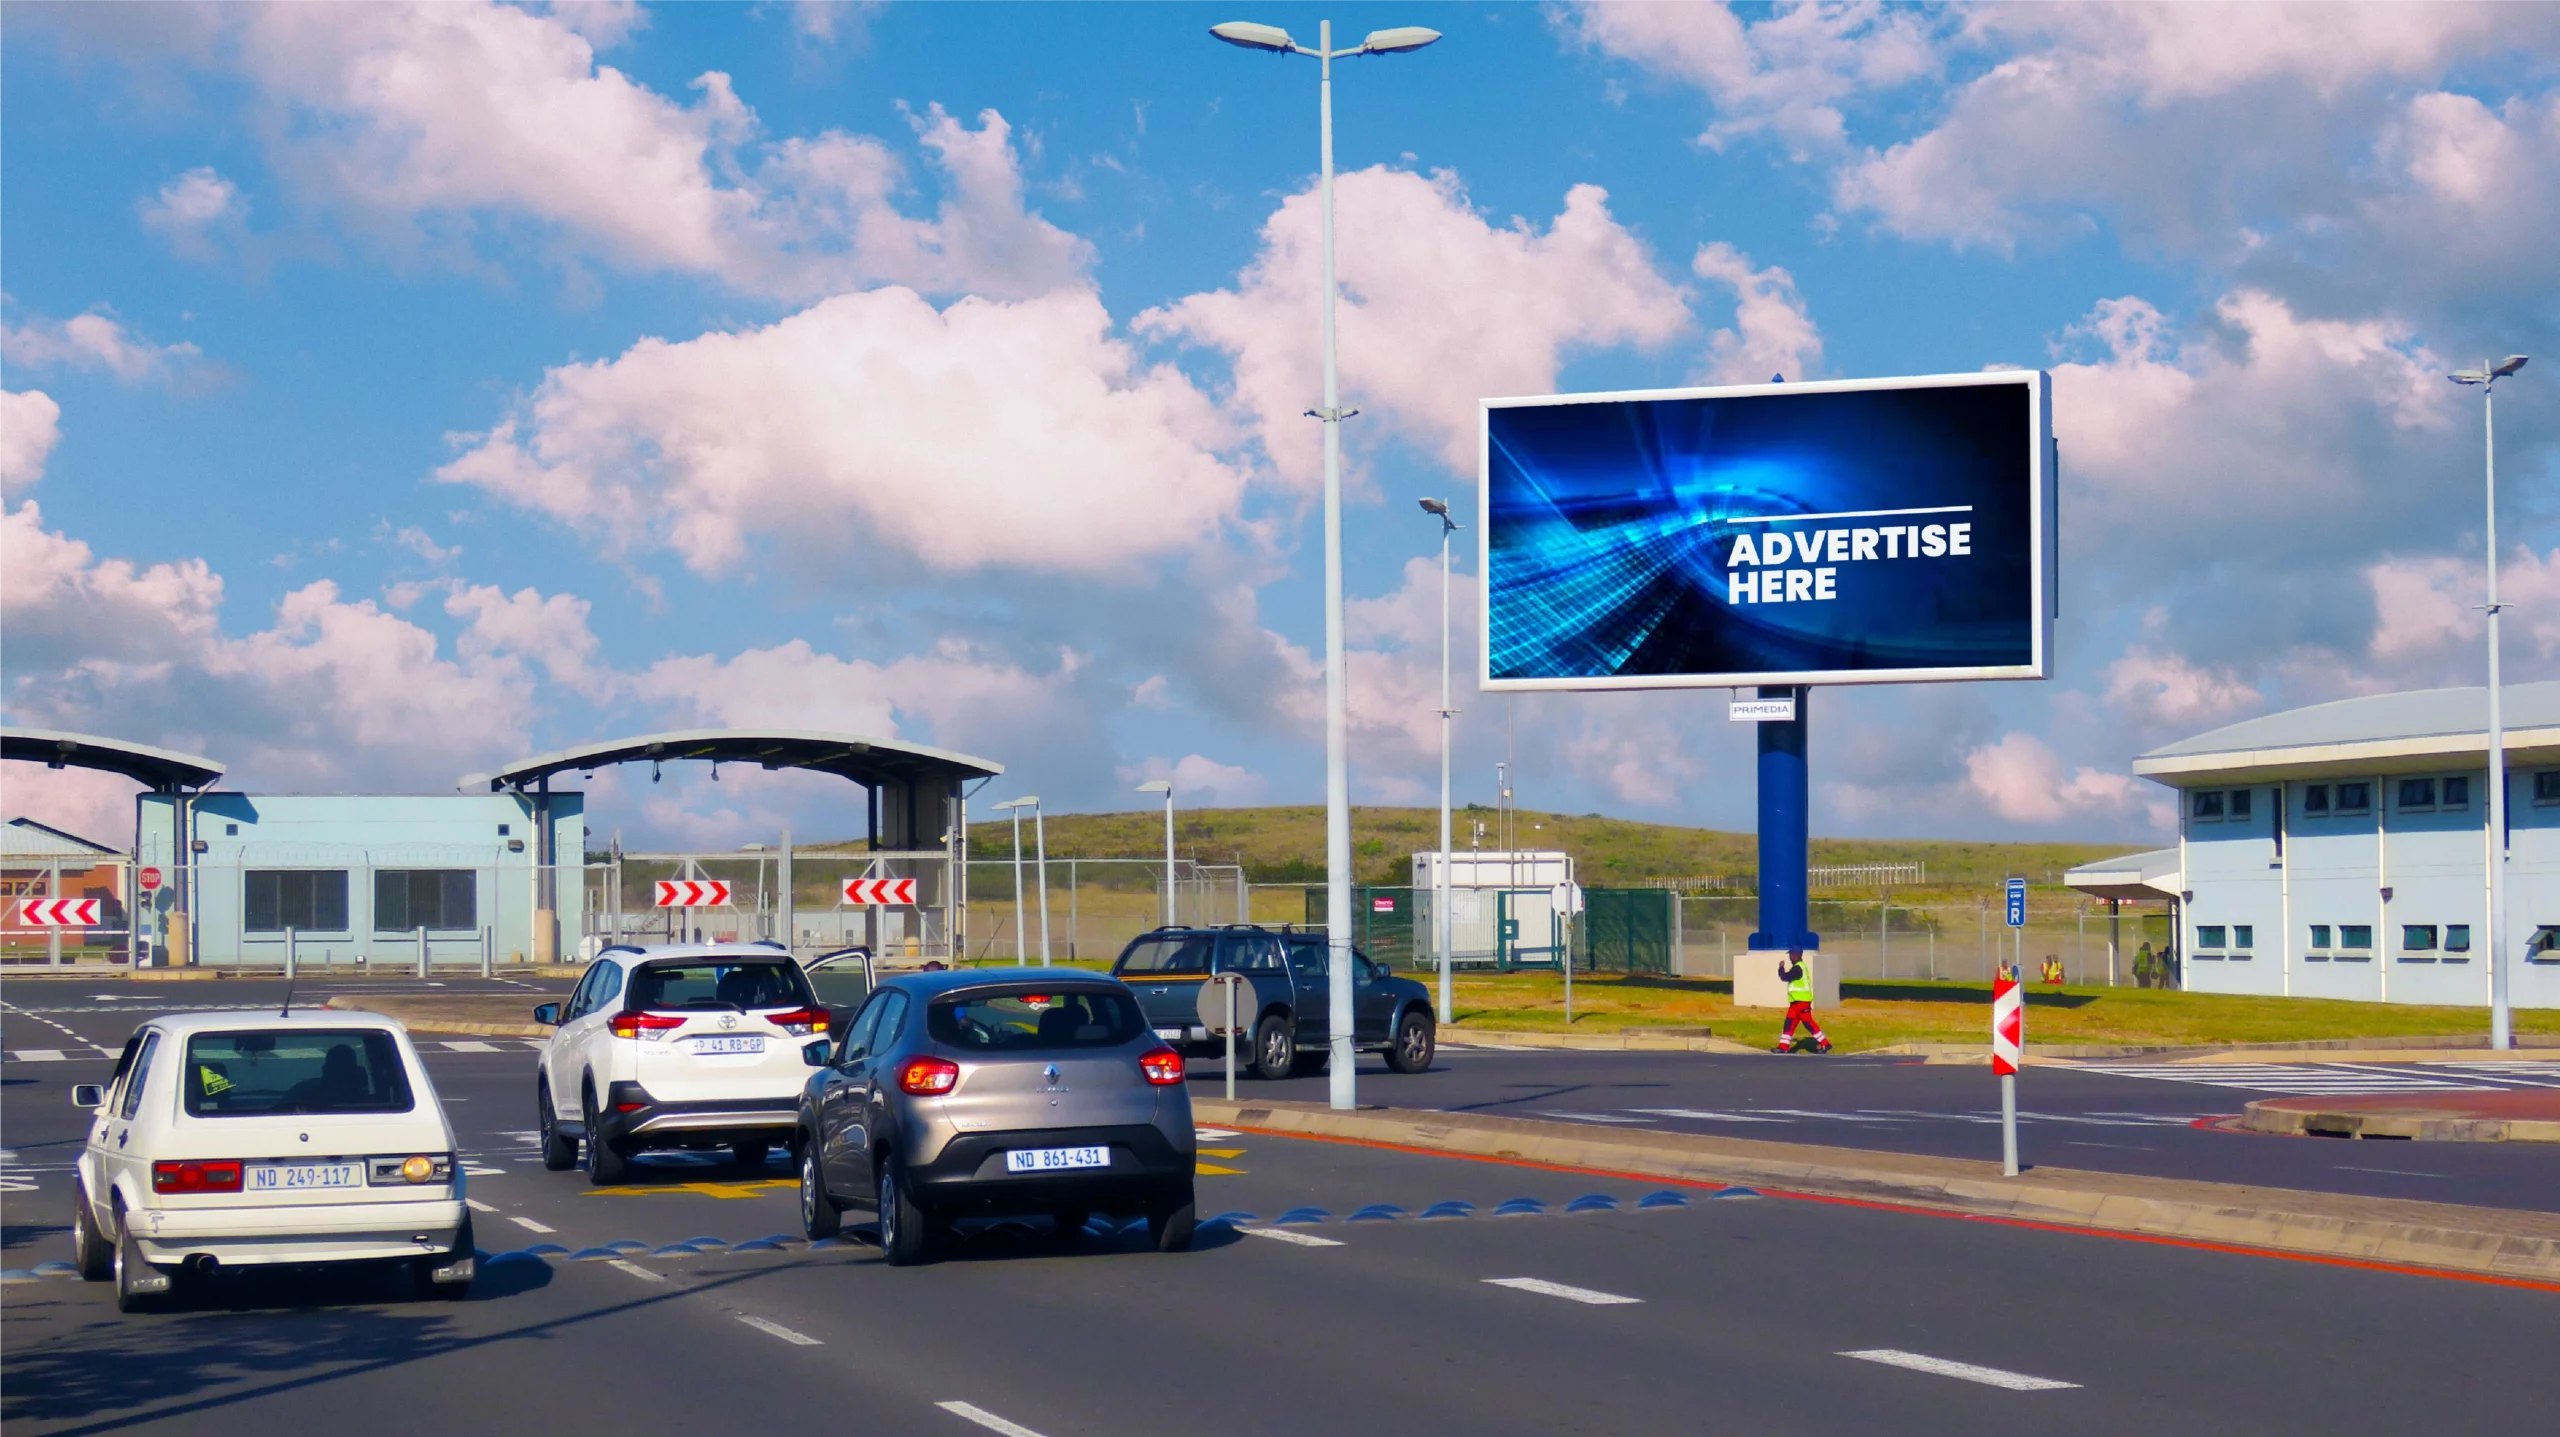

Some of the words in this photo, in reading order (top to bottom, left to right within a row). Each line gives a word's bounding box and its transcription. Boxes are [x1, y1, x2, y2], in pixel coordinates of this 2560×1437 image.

[1727, 523, 1971, 567] ADVERTISE
[1729, 567, 1836, 604] HERE
[1733, 705, 1790, 714] PRIMEDIA
[141, 872, 160, 883] STOP
[2010, 907, 2020, 924] R
[712, 1040, 724, 1052] 41
[729, 1039, 742, 1051] RB
[750, 1038, 762, 1050] GP
[1015, 1152, 1034, 1168] ND
[1043, 1149, 1101, 1167] 861-431
[256, 1169, 277, 1187] ND
[286, 1167, 350, 1186] 249-117
